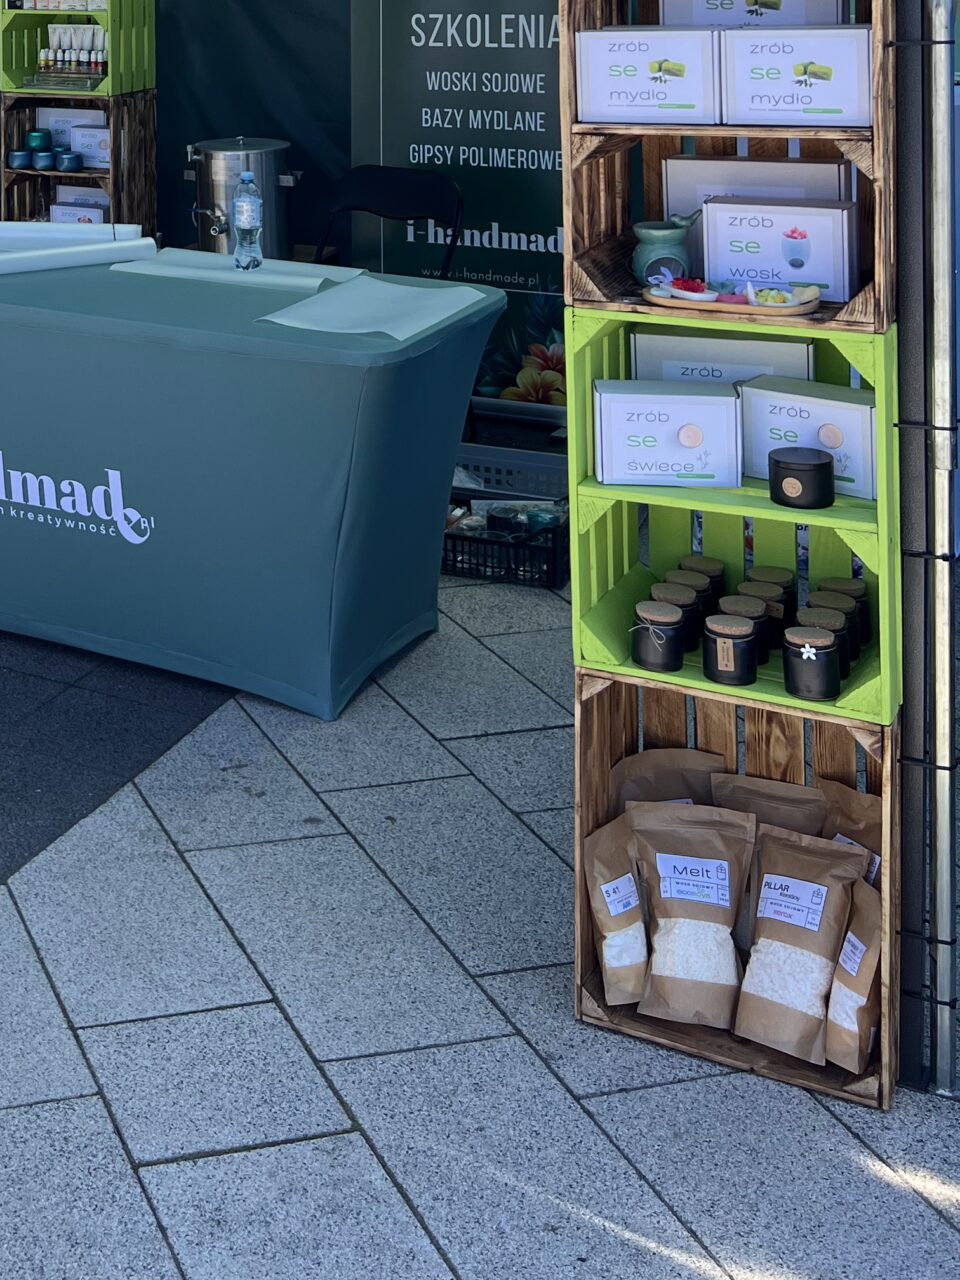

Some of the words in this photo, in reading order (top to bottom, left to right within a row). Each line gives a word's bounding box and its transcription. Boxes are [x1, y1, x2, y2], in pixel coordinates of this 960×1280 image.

[411, 13, 559, 48] SZKOLENIA
[608, 41, 649, 52] zrób
[750, 43, 794, 54] zrób
[608, 64, 638, 77] se
[750, 67, 781, 80] se
[426, 71, 477, 92] WOSKI
[481, 73, 546, 94] SOJOWE
[421, 107, 464, 129] BAZY
[469, 109, 546, 132] MYDLANE
[409, 143, 454, 165] GIPSY
[459, 146, 562, 171] POLIMEROWE
[729, 216, 774, 229] zrób
[729, 239, 761, 254] se
[729, 267, 782, 281] wosk
[681, 366, 723, 379] zrób
[626, 411, 670, 423] zrób
[769, 404, 810, 419] zrób
[627, 435, 658, 448] se
[769, 427, 798, 443] se
[627, 460, 695, 473] świece
[10, 506, 117, 536] kreatywność
[673, 865, 712, 879] Melt
[763, 881, 790, 893] PILLAR
